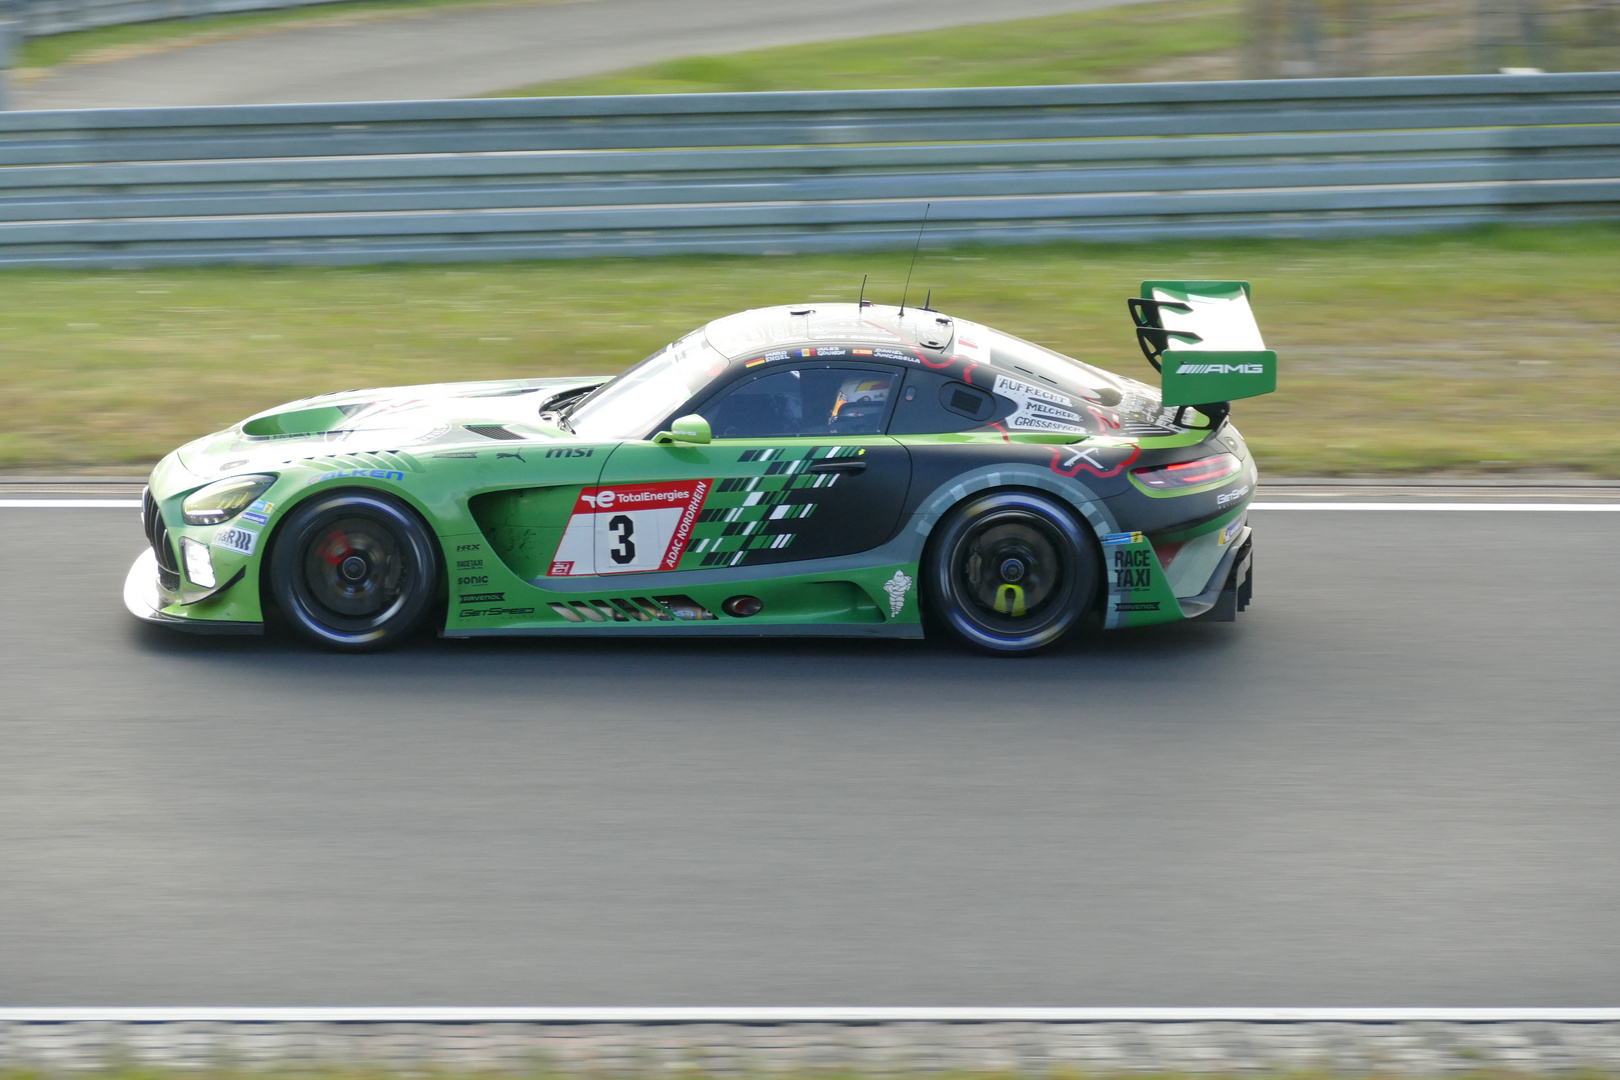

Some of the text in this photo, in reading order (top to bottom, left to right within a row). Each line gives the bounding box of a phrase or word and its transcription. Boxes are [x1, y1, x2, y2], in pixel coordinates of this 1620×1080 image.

[874, 348, 904, 356] DANIEL
[874, 352, 921, 364] JUNCADELLA
[1204, 364, 1263, 374] AMG
[999, 378, 1067, 403] AUFRECHT
[1014, 416, 1081, 432] GROSSASPACH
[545, 447, 595, 459] msi
[307, 469, 404, 486] FALKEN
[616, 489, 690, 504] TotalEnergies
[665, 481, 707, 568] ADAC NORDRHEIN
[608, 514, 636, 565] 3
[1114, 550, 1151, 568] RACE
[1114, 568, 1151, 587] TAXI
[462, 594, 502, 602] RAVENOL
